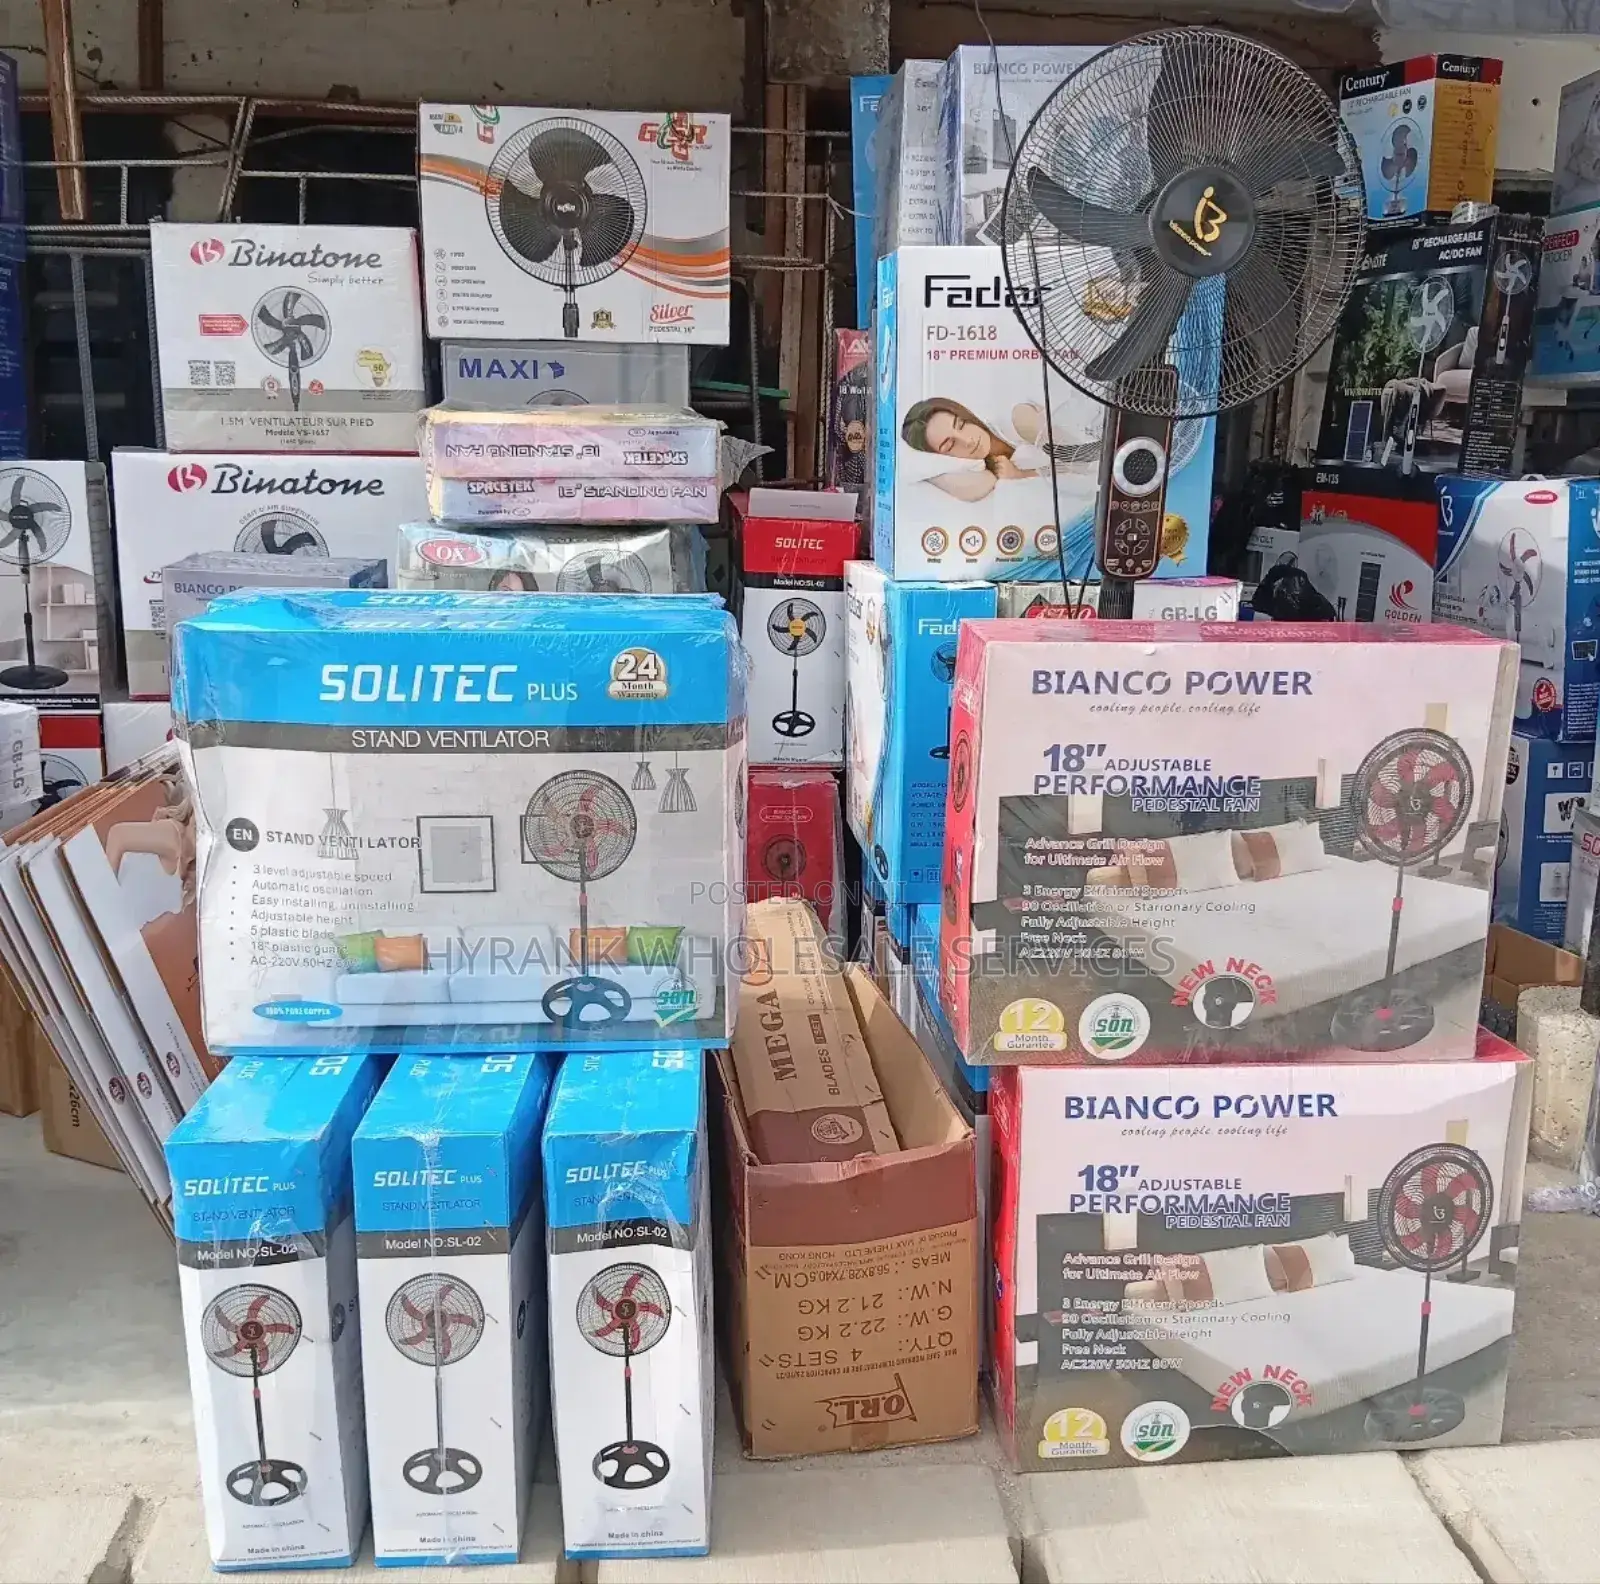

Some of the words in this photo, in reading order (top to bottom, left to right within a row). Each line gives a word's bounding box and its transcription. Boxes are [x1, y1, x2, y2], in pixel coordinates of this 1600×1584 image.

[1345, 72, 1386, 91] Century
[1425, 230, 1484, 248] RECHARGEABLE
[228, 238, 382, 268] Binatone
[1466, 246, 1483, 258] FAN
[308, 271, 345, 286] Simply
[349, 273, 385, 285] better
[649, 303, 696, 324] Silver
[926, 325, 998, 341] FD-1618
[926, 350, 947, 361] 18"
[949, 349, 1009, 361] PREMIUM
[458, 357, 539, 380] MAXI
[249, 416, 324, 427] VENTILATEUR
[326, 417, 347, 427] SUR
[349, 418, 375, 427] PIED
[445, 445, 483, 458] FAN
[487, 445, 574, 457] STANDING
[210, 462, 385, 497] Binatone
[583, 484, 666, 498] STANDING
[671, 485, 708, 498] FAN
[774, 536, 826, 551] SOLITEC
[1160, 605, 1218, 622] GB-LG
[1384, 609, 1422, 623] GOLDEN
[616, 651, 659, 681] 24
[319, 664, 519, 703] SOLITEC
[526, 683, 578, 701] PLUS
[621, 682, 655, 690] Month
[1031, 669, 1172, 696] BIANCO
[1185, 669, 1313, 696] POWER
[1088, 703, 1136, 716] cooling
[1188, 703, 1235, 717] cooling
[1238, 702, 1261, 717] life
[351, 730, 420, 748] STAND
[426, 729, 551, 748] VENTILATOR
[1043, 743, 1107, 772] 18"
[1105, 758, 1212, 772] ADJUSTABLE
[1033, 774, 1261, 797] PERFORMANCE
[1132, 797, 1221, 812] PEDESTAL
[1223, 797, 1260, 812] FAN
[232, 828, 253, 841] EN
[266, 830, 315, 846] STAND
[1024, 837, 1085, 850] Advance
[1086, 837, 1115, 850] Grill
[1117, 838, 1166, 853] Design
[1023, 853, 1045, 866] for
[1047, 853, 1107, 866] Ultimate
[1108, 853, 1131, 866] Air
[1132, 853, 1165, 866] Flow
[253, 864, 261, 875] 3
[262, 864, 289, 876] level
[291, 867, 352, 881] adjustable
[354, 872, 393, 884] speed
[252, 879, 310, 894] Automatic
[1034, 884, 1081, 900] Energy
[251, 894, 280, 909] Easy
[1041, 900, 1114, 912] Oscillation
[1134, 901, 1201, 916] Stationary
[1205, 901, 1257, 915] Cooling
[250, 909, 314, 926] Adjustable
[316, 913, 354, 927] height
[1020, 915, 1054, 931] Fully
[1055, 915, 1128, 930] Adjustable
[1131, 916, 1176, 930] Height
[250, 925, 258, 936] 5
[260, 925, 299, 940] plastic
[301, 928, 335, 940] blade
[1020, 932, 1050, 944] Free
[1052, 931, 1088, 944] Neck
[271, 941, 312, 954] plastic
[1170, 958, 1216, 1007] NEW
[1225, 956, 1279, 1006] NECK
[1008, 1002, 1053, 1030] 12
[756, 988, 798, 1082] MEGA
[1014, 1033, 1049, 1043] Month
[816, 1048, 841, 1096] BLADES
[1064, 1095, 1200, 1120] BIANCO
[1213, 1093, 1339, 1119] POWER
[1120, 1126, 1166, 1139] cooling
[1217, 1125, 1262, 1139] cooling
[1265, 1124, 1288, 1137] life
[183, 1175, 270, 1197] SOLITEC
[272, 1181, 297, 1191] PLUS
[372, 1169, 458, 1188] SOLITEC
[460, 1175, 483, 1184] PLUS
[1077, 1164, 1140, 1193] 18"
[1138, 1178, 1243, 1192] ADJUSTABLE
[1069, 1192, 1291, 1214] PERFORMANCE
[1165, 1214, 1251, 1229] PEDESTAL
[1254, 1213, 1291, 1228] FAN
[384, 1238, 421, 1250] Model
[576, 1229, 612, 1244] Model
[197, 1248, 235, 1262] Model
[1062, 1252, 1121, 1266] Advance
[1122, 1252, 1151, 1266] Grill
[1152, 1253, 1200, 1268] Design
[1062, 1267, 1083, 1281] for
[1085, 1267, 1144, 1281] Ultimate
[1145, 1267, 1166, 1281] Air
[1167, 1268, 1200, 1281] Flow
[798, 1298, 831, 1314] KG
[1073, 1298, 1120, 1313] Energy
[839, 1316, 886, 1337] 22.2
[1081, 1313, 1152, 1325] Oscillation
[1171, 1313, 1238, 1327] Stationary
[1240, 1311, 1291, 1324] Cooling
[797, 1324, 830, 1342] KG
[1062, 1328, 1093, 1343] Fully
[1094, 1328, 1167, 1342] Adjustable
[1168, 1328, 1213, 1342] Height
[850, 1348, 863, 1362] 4
[1062, 1344, 1091, 1356] Free
[1092, 1344, 1127, 1356] Neck
[777, 1349, 838, 1369] SETS
[1060, 1357, 1113, 1370] AC220V
[1115, 1357, 1150, 1370] 50HZ
[1209, 1367, 1253, 1413] NEW
[1262, 1363, 1315, 1409] NECK
[1051, 1412, 1094, 1438] 12
[1058, 1441, 1093, 1450] Month
[640, 1529, 664, 1538] china
[247, 1547, 270, 1555] Made
[281, 1544, 306, 1552] china
